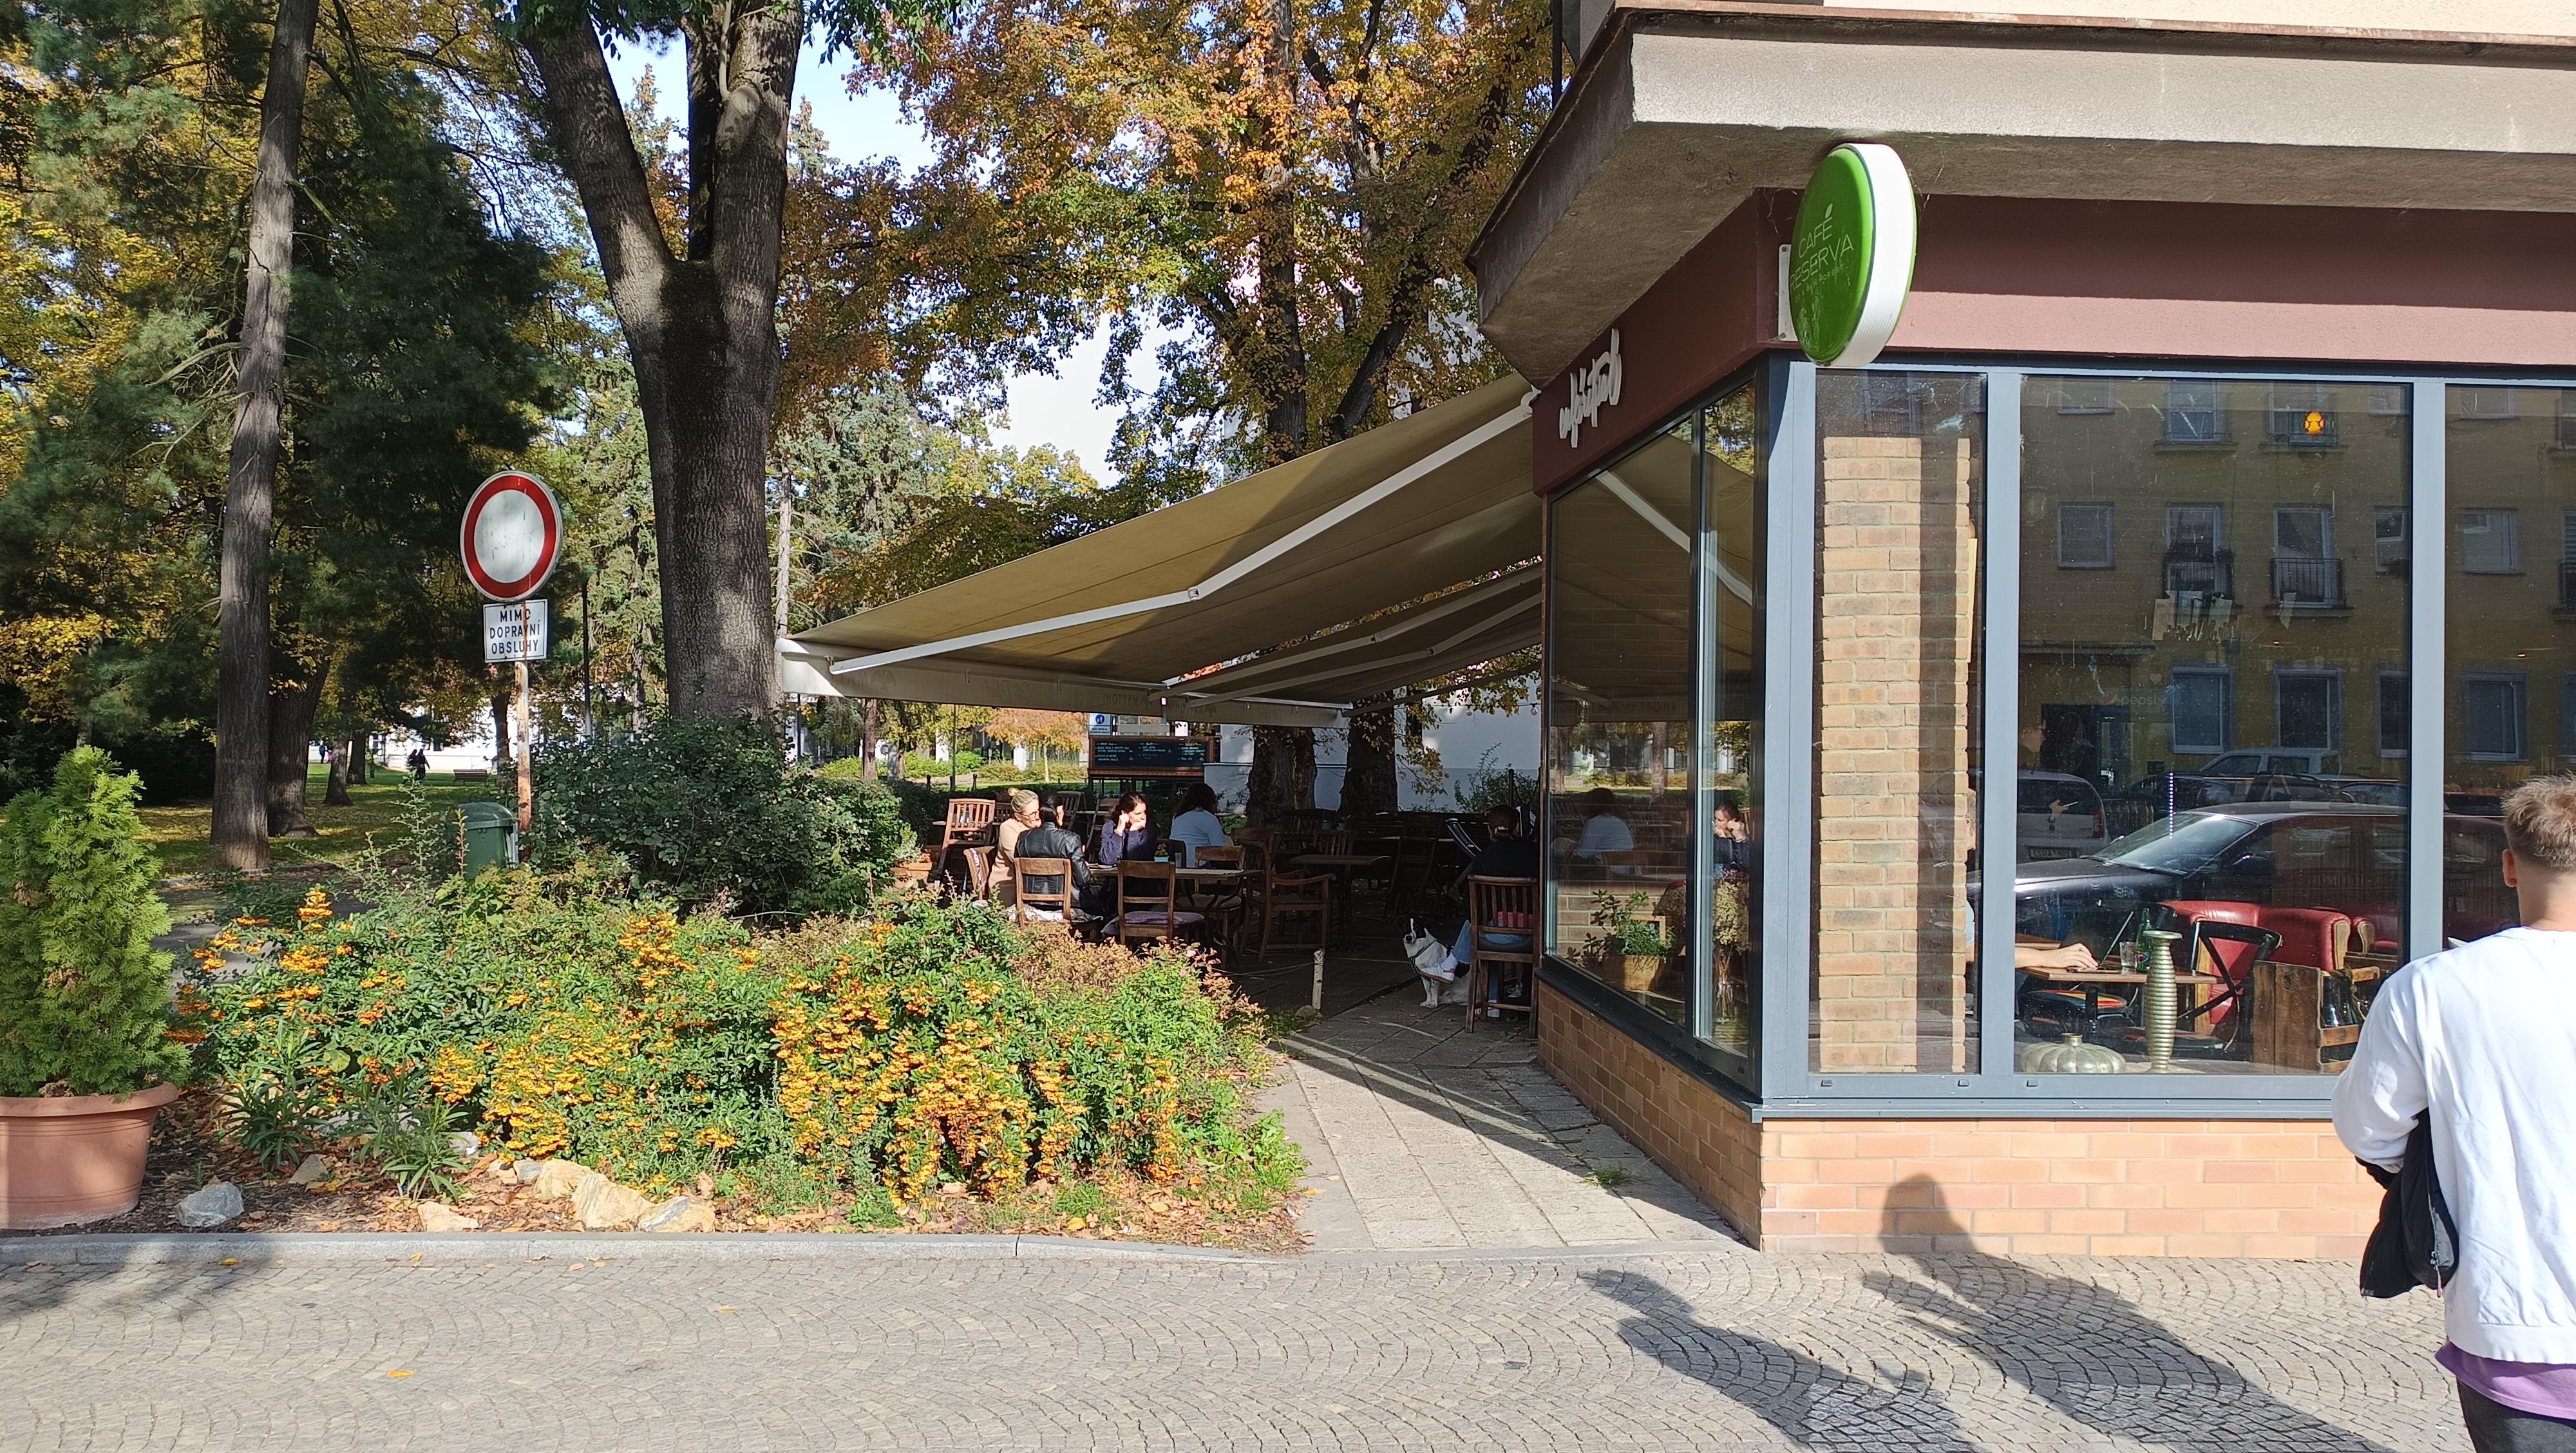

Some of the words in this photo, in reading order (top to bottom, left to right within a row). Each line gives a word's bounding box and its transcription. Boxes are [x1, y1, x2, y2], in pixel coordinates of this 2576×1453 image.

[1798, 204, 1833, 258] CAFÉ
[1790, 234, 1854, 291] RESERVA
[500, 609, 531, 622] MIMO
[489, 619, 541, 640] DOPRAVNÍ
[491, 639, 539, 655] OBSLUHY
[2121, 695, 2157, 707] pepsi
